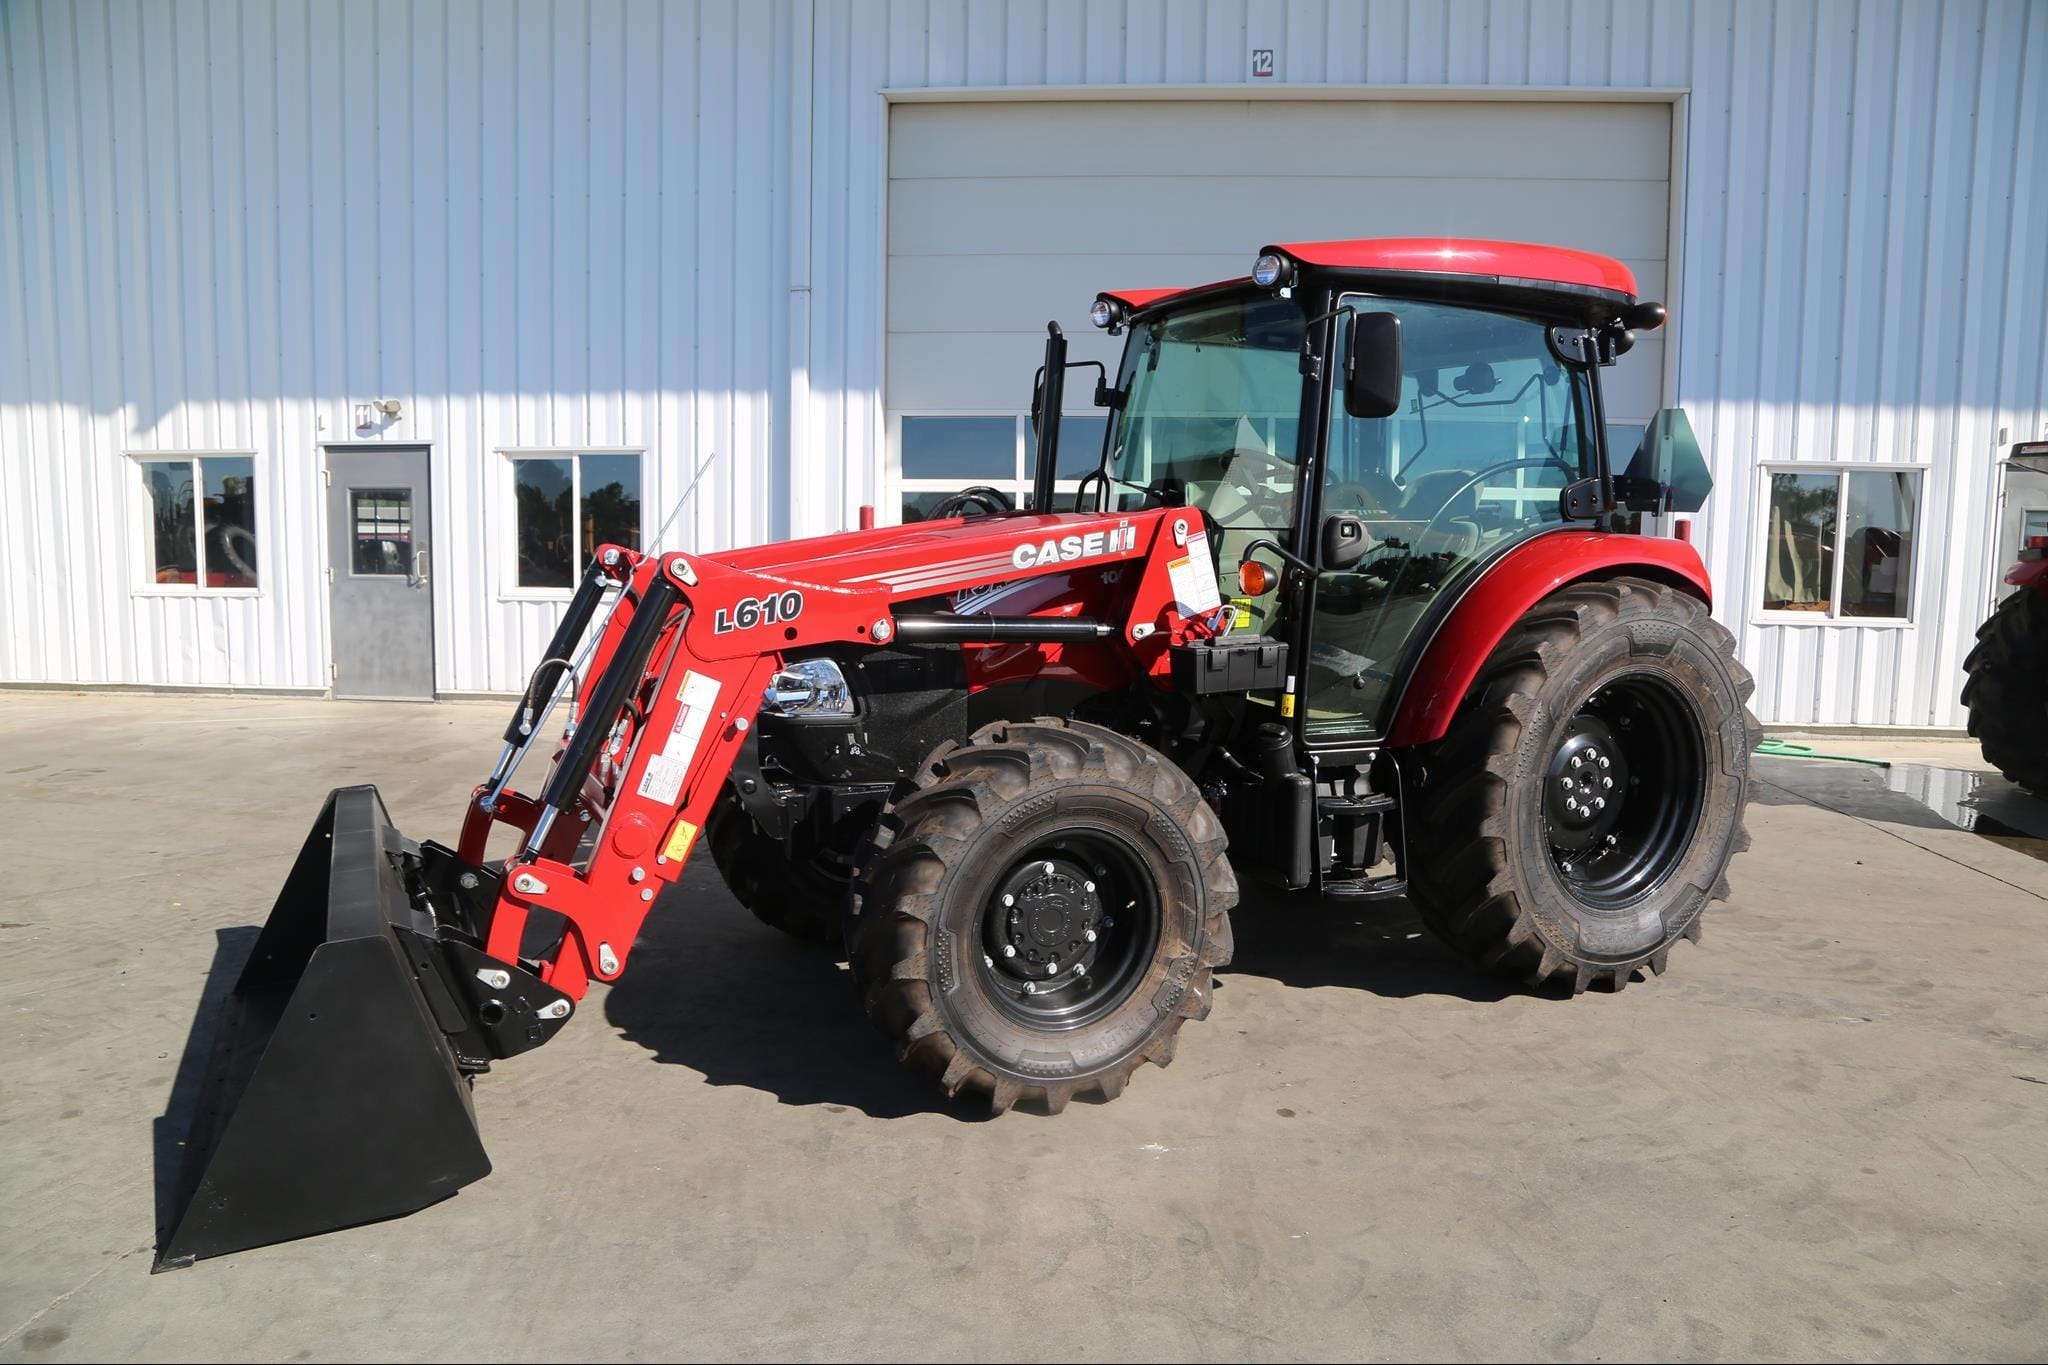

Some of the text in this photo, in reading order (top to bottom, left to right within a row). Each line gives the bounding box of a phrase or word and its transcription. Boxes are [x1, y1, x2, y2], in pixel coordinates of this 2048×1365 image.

[1253, 51, 1272, 73] 12
[1012, 531, 1104, 569] CASE
[714, 590, 803, 634] L610
